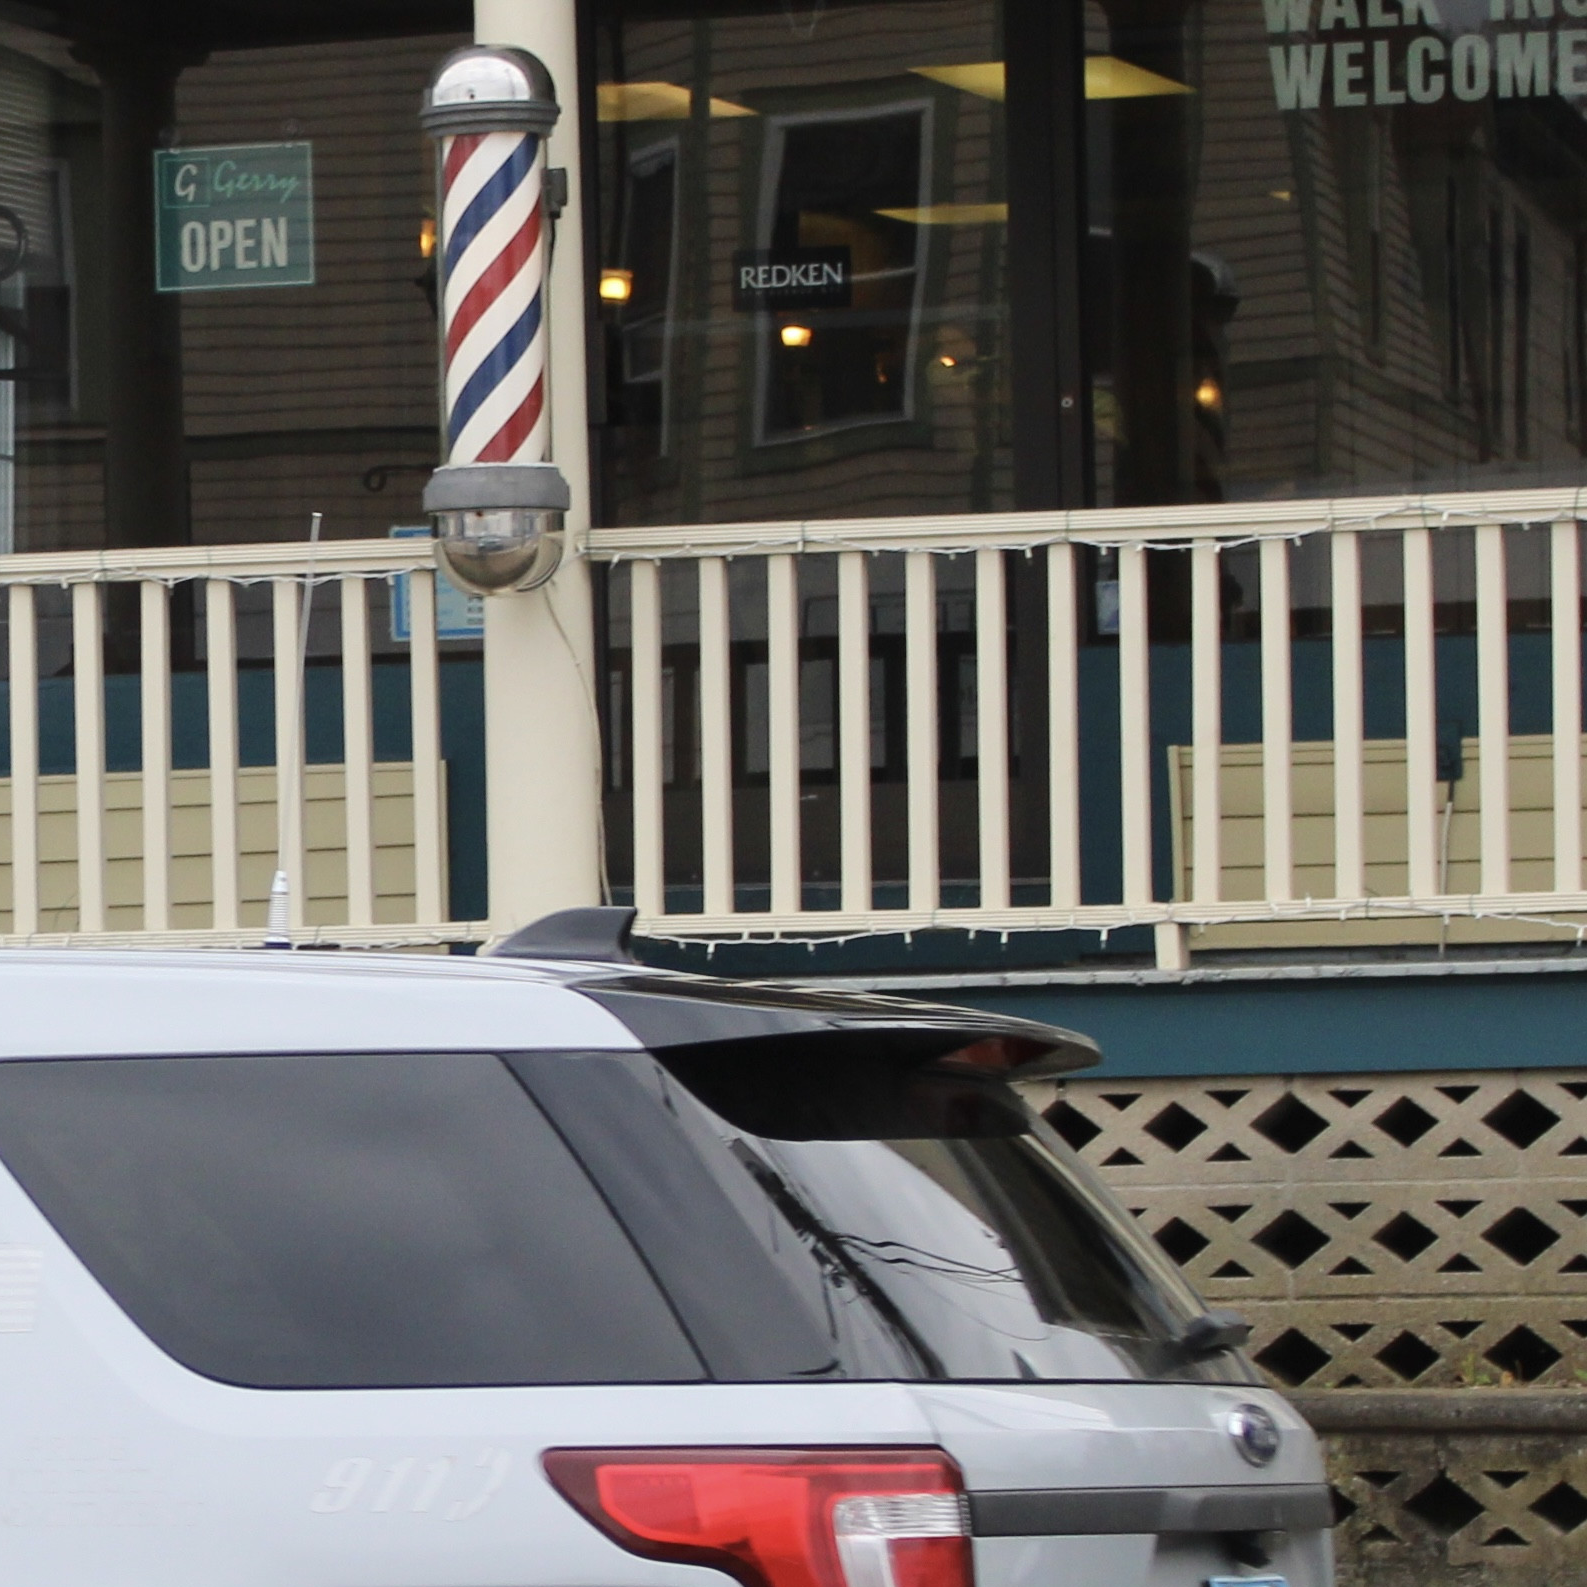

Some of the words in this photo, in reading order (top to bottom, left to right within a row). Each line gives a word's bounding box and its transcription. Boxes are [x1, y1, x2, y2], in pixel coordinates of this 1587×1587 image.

[1268, 29, 1587, 111] WELCOME
[213, 160, 300, 204] Gerry
[181, 217, 289, 273] OPEN
[740, 263, 843, 290] REDKEN
